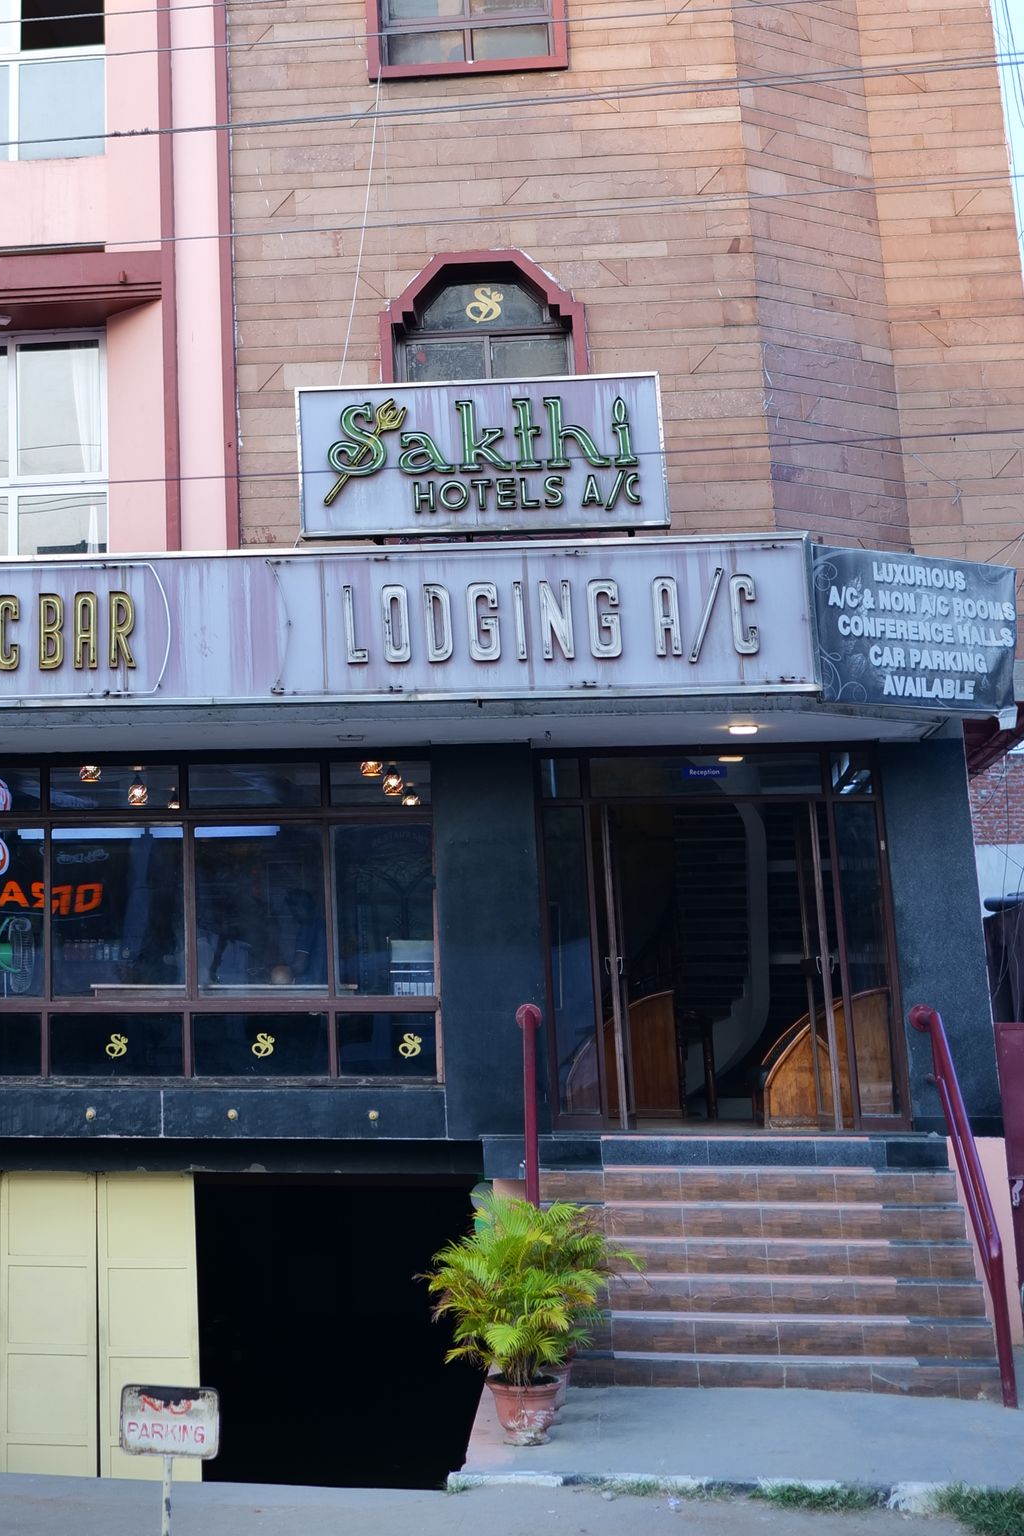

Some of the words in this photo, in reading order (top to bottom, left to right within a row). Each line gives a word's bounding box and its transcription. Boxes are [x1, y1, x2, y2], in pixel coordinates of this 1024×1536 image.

[328, 396, 639, 476] Sakthi
[413, 476, 565, 513] HOTELS
[582, 470, 642, 511] A/C
[873, 561, 966, 591] LUXURIOUS
[342, 576, 623, 664] LODGING
[652, 566, 761, 663] A/C
[828, 586, 859, 609] A/C
[862, 588, 875, 610] &
[878, 589, 916, 613] NON
[920, 593, 949, 616] A/C
[952, 596, 1016, 622] ROOMS
[38, 590, 137, 670] BAR
[837, 614, 954, 644] CONFERENCE
[957, 624, 1014, 648] HALLS
[869, 645, 906, 668] CAR
[909, 648, 988, 674] PARKING
[883, 674, 976, 700] AVAILABLE
[689, 769, 720, 777] Reception
[140, 1394, 193, 1416] NO
[127, 1421, 206, 1444] PARKING
